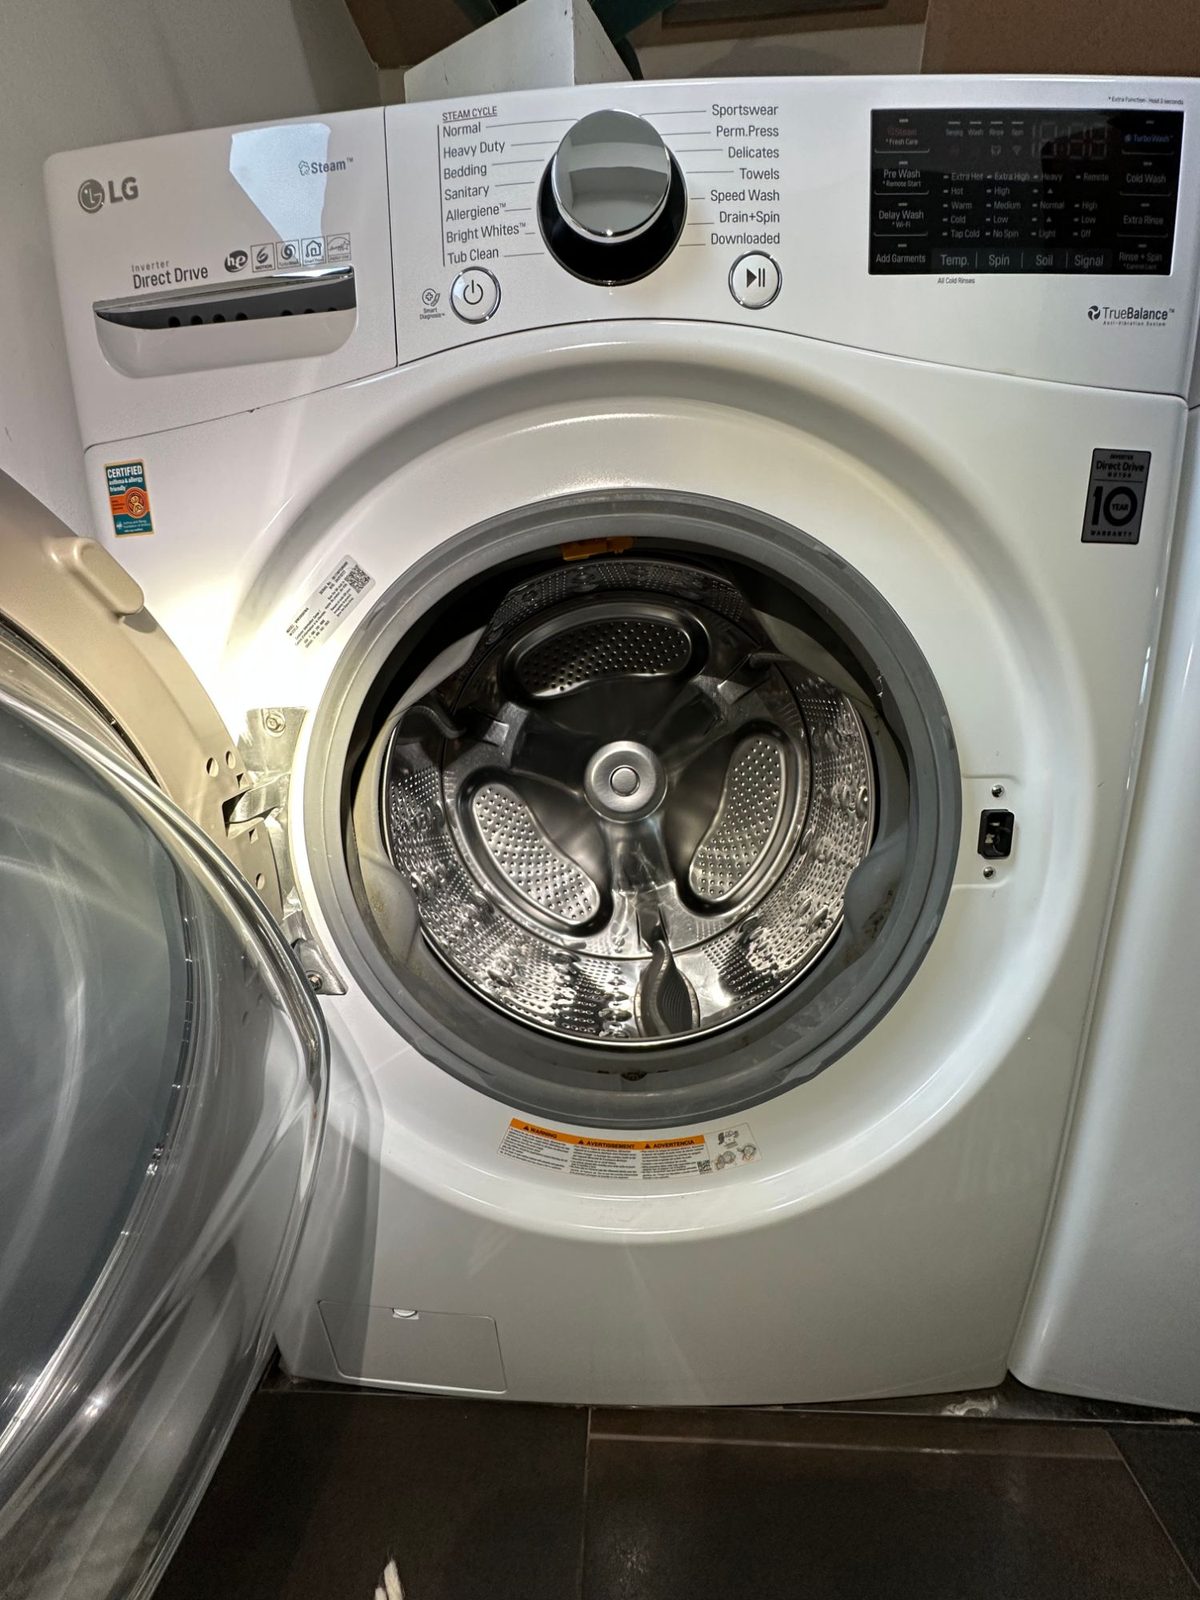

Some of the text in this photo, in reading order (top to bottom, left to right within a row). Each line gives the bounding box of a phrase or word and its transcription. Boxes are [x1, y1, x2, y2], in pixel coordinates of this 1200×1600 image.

[442, 106, 498, 121] STEAM CYCLE
[711, 104, 779, 118] Sportswear
[442, 122, 481, 138] Normal
[716, 125, 779, 137] Perm.Press
[443, 141, 506, 159] Heavy Duty
[728, 146, 780, 159] Delicates
[443, 164, 487, 180] Bedding
[739, 168, 780, 180] Towels
[884, 169, 921, 178] Pre Wash
[1126, 173, 1167, 183] Cold Wash
[108, 176, 139, 204] LG
[444, 185, 490, 201] Sanitary
[951, 187, 964, 195] Hot
[994, 187, 1010, 196] High
[710, 189, 780, 204] Speed Wash
[951, 201, 972, 209] Warm
[994, 201, 1021, 209] Medium
[1040, 201, 1065, 209] Normal
[1082, 201, 1098, 211] High
[719, 210, 780, 225] Drain+Spin
[879, 210, 924, 221] Delay Wash
[950, 216, 967, 224] Cold
[993, 215, 1009, 223] Low
[1081, 215, 1096, 223] Low
[1123, 215, 1143, 225] Extra
[446, 228, 479, 244] Bright
[711, 232, 780, 245] Downloaded
[951, 230, 980, 239] Tap Cold
[993, 230, 1019, 239] No Spin
[448, 248, 499, 264] Tub Clean
[876, 253, 927, 263] Add Garments
[940, 254, 970, 267] Temp.
[989, 254, 1011, 267] Spin
[1035, 254, 1054, 266] Soil
[1074, 254, 1104, 268] Signal
[131, 260, 170, 273] Inverter
[133, 266, 209, 289] Direct Drive
[107, 465, 143, 479] CERTIFIED
[1096, 460, 1145, 473] Direct Drive
[1091, 485, 1138, 527] 10
[1112, 503, 1129, 511] YEAR
[1090, 530, 1132, 538] WARRANTY
[530, 1127, 558, 1139] WARNING
[653, 1139, 695, 1149] ADVERTENCIA
